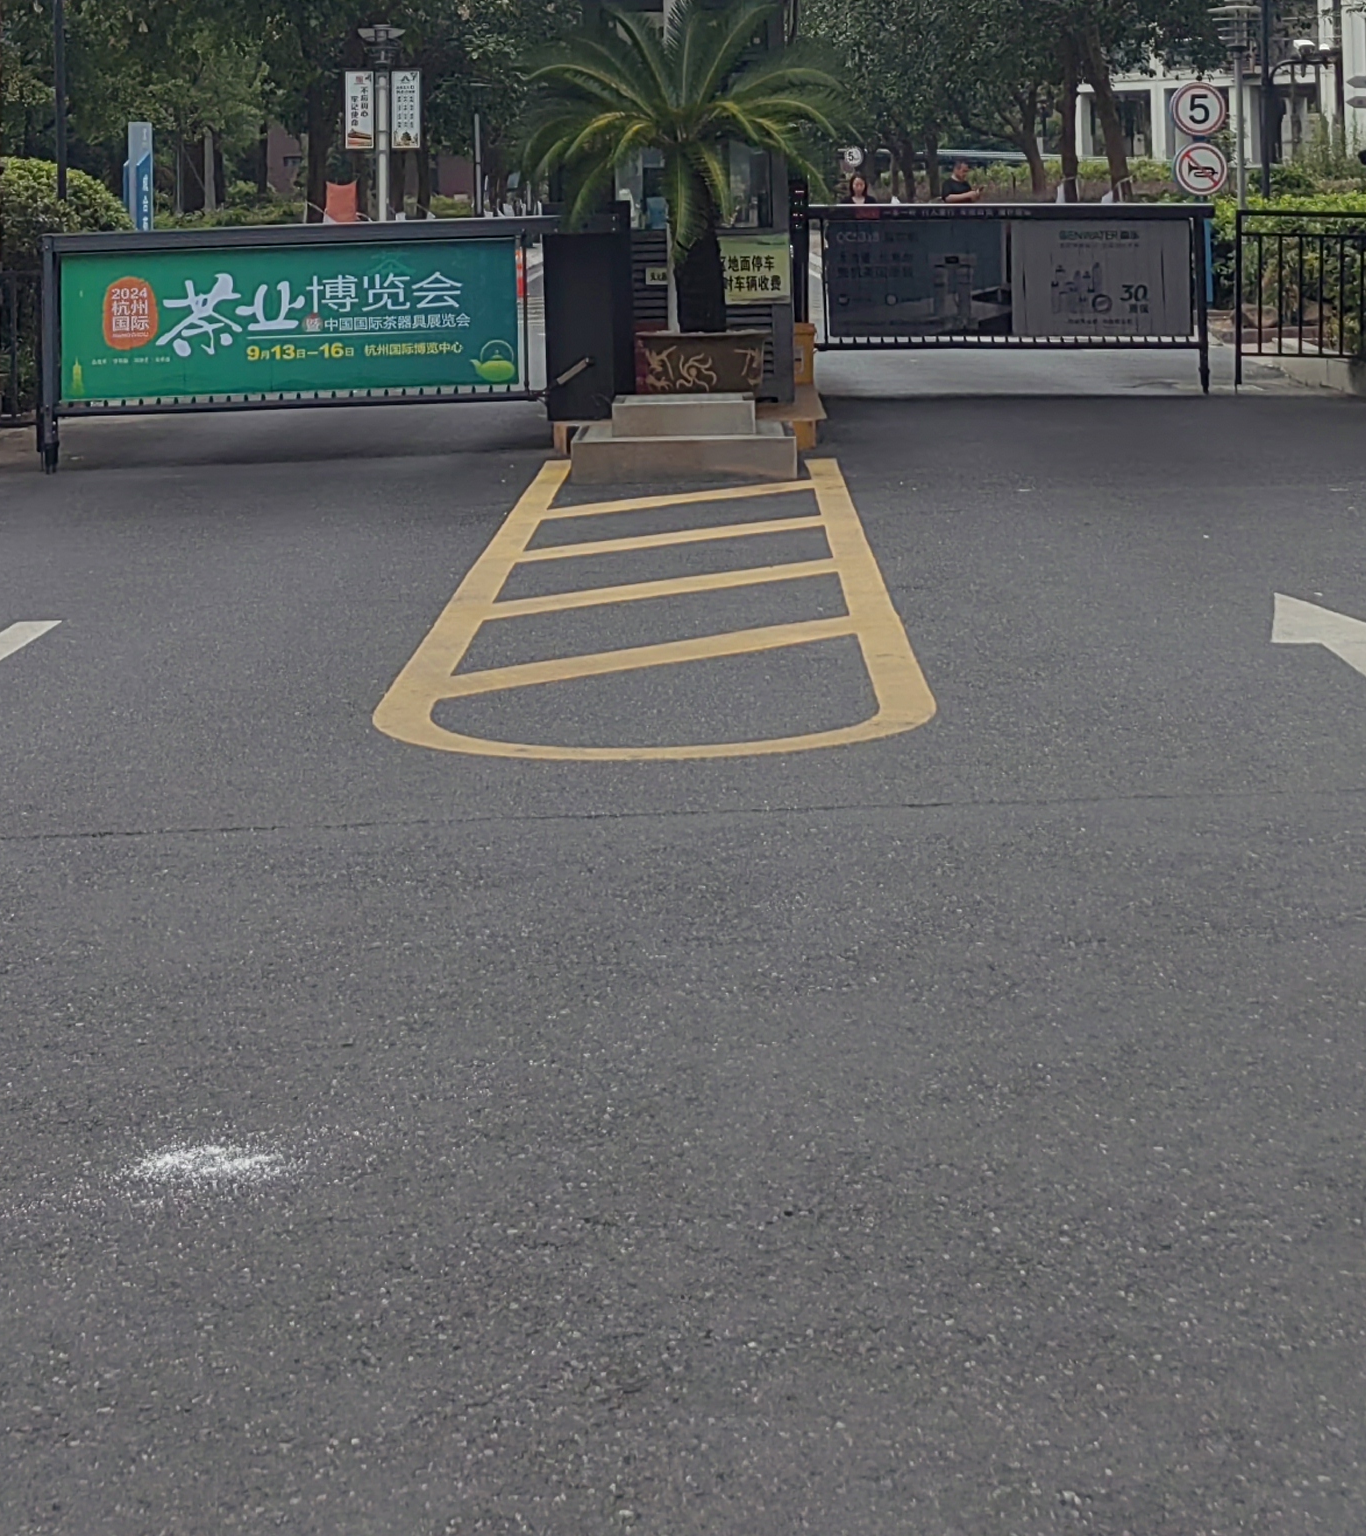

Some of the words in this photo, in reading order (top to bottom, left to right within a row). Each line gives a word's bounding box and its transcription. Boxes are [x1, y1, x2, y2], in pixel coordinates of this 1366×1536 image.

[1189, 94, 1210, 124] 5
[111, 287, 148, 300] 2024
[112, 299, 149, 316] 杭州
[155, 273, 306, 357] 茶业
[306, 271, 463, 313] 博览会
[112, 315, 150, 332] 国际
[324, 312, 471, 332] 中国国际茶器具展览会
[364, 342, 464, 357] 杭州国际博览中心
